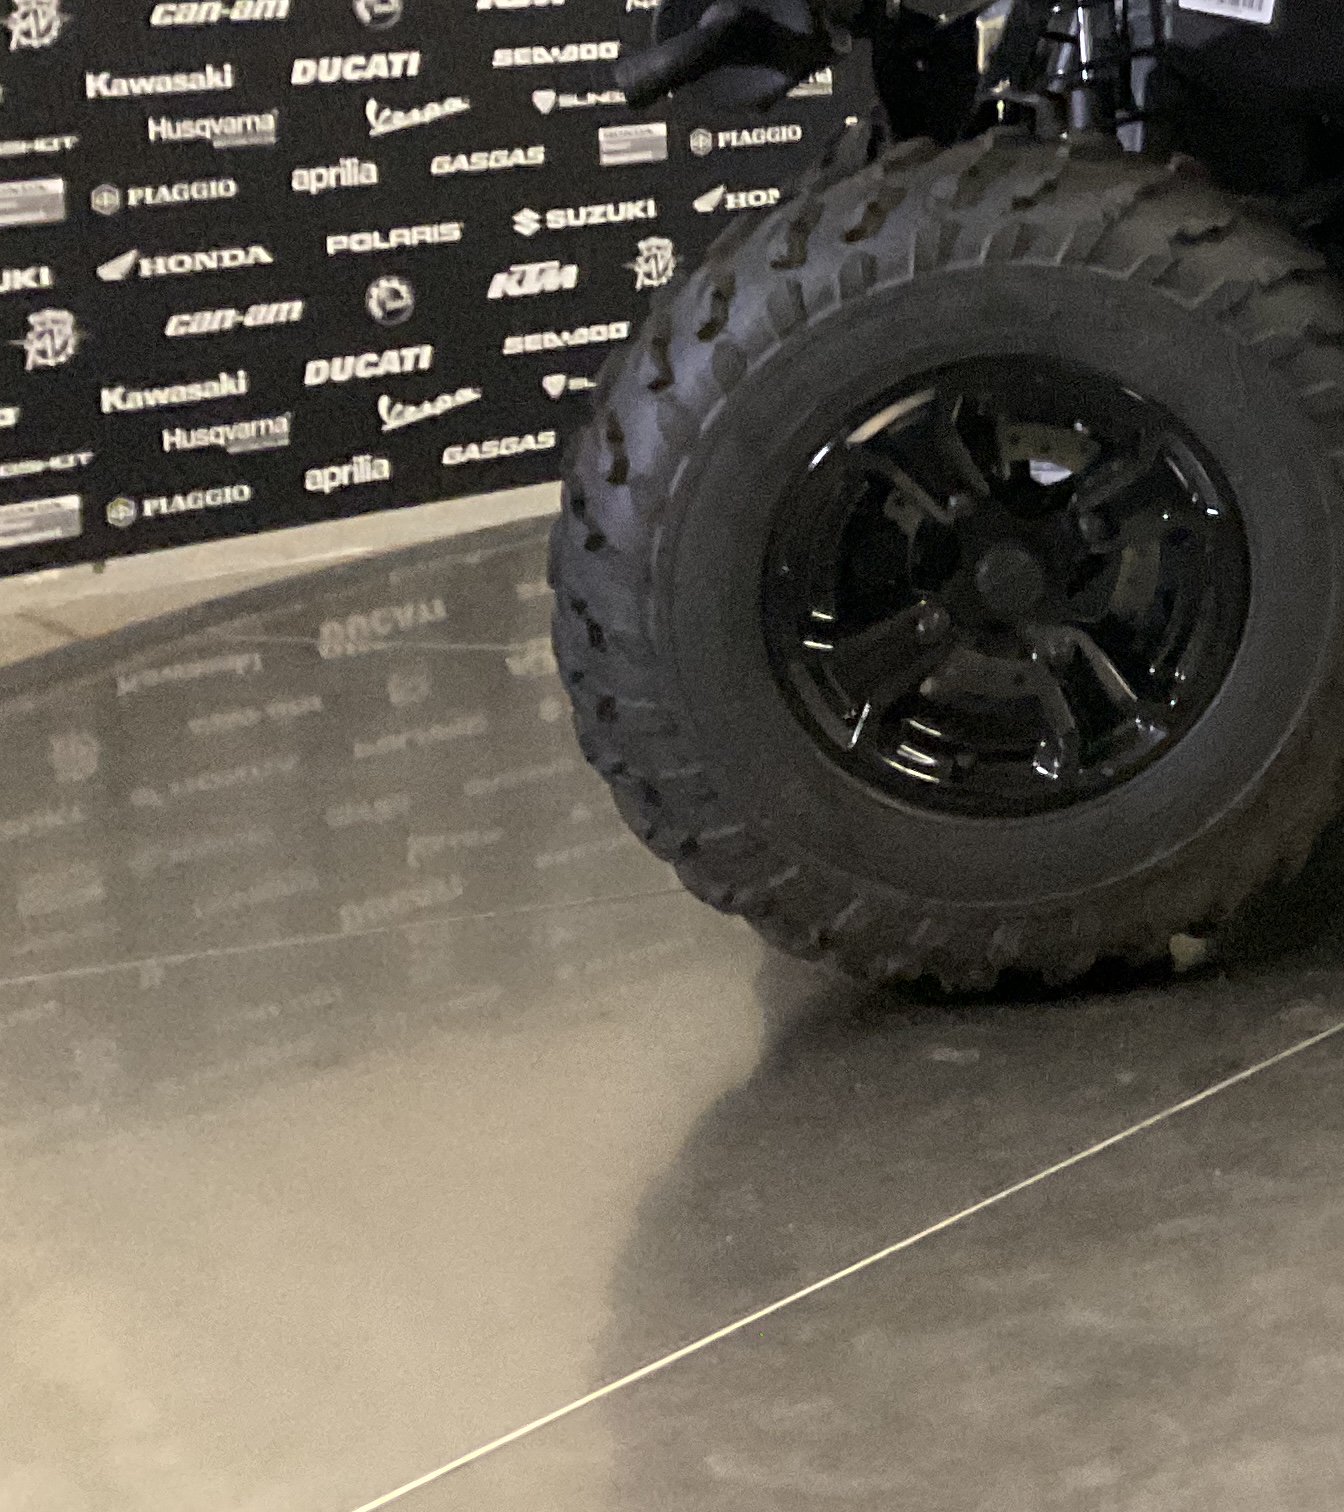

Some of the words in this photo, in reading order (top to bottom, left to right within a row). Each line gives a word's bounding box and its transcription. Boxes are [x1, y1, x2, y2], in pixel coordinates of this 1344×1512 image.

[86, 63, 235, 99] Kawasaki
[291, 50, 422, 86] DUCATI
[148, 109, 277, 144] Husqvarna
[365, 96, 471, 137] Vespa
[718, 124, 803, 149] PIAGGIO
[291, 156, 379, 195] aprilia
[430, 146, 546, 176] GASGAS
[128, 178, 238, 208] PIAGGIO
[546, 197, 658, 231] SUZUKI
[326, 222, 463, 256] POLARIS
[139, 245, 274, 278] HONDA
[487, 259, 580, 300] KTM
[164, 299, 305, 337] can-am
[303, 344, 433, 387] DUCATI
[100, 369, 248, 414] Kawasaki
[377, 387, 482, 432] Vespa
[162, 412, 291, 453] Husqvarna
[441, 430, 556, 466] GASGAS
[304, 453, 391, 494] aprilia
[143, 484, 253, 518] PIAGGIO
